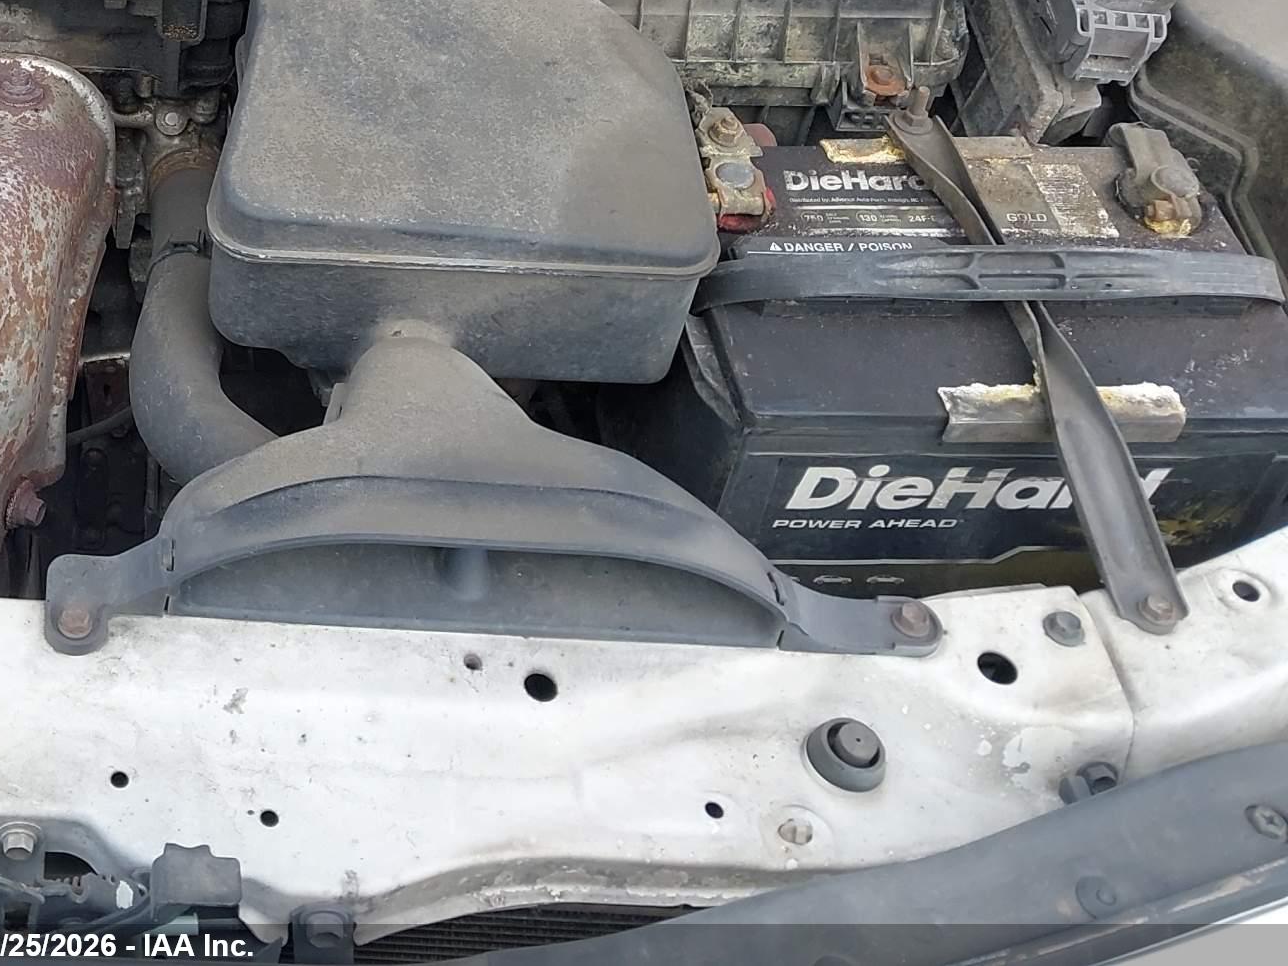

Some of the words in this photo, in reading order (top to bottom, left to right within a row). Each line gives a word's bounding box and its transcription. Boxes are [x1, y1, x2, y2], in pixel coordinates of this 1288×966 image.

[1006, 213, 1047, 222] GOLD
[784, 243, 843, 252] DANGER
[861, 243, 912, 251] POISON
[772, 519, 860, 529] POWER
[869, 519, 959, 529] AHEAD
